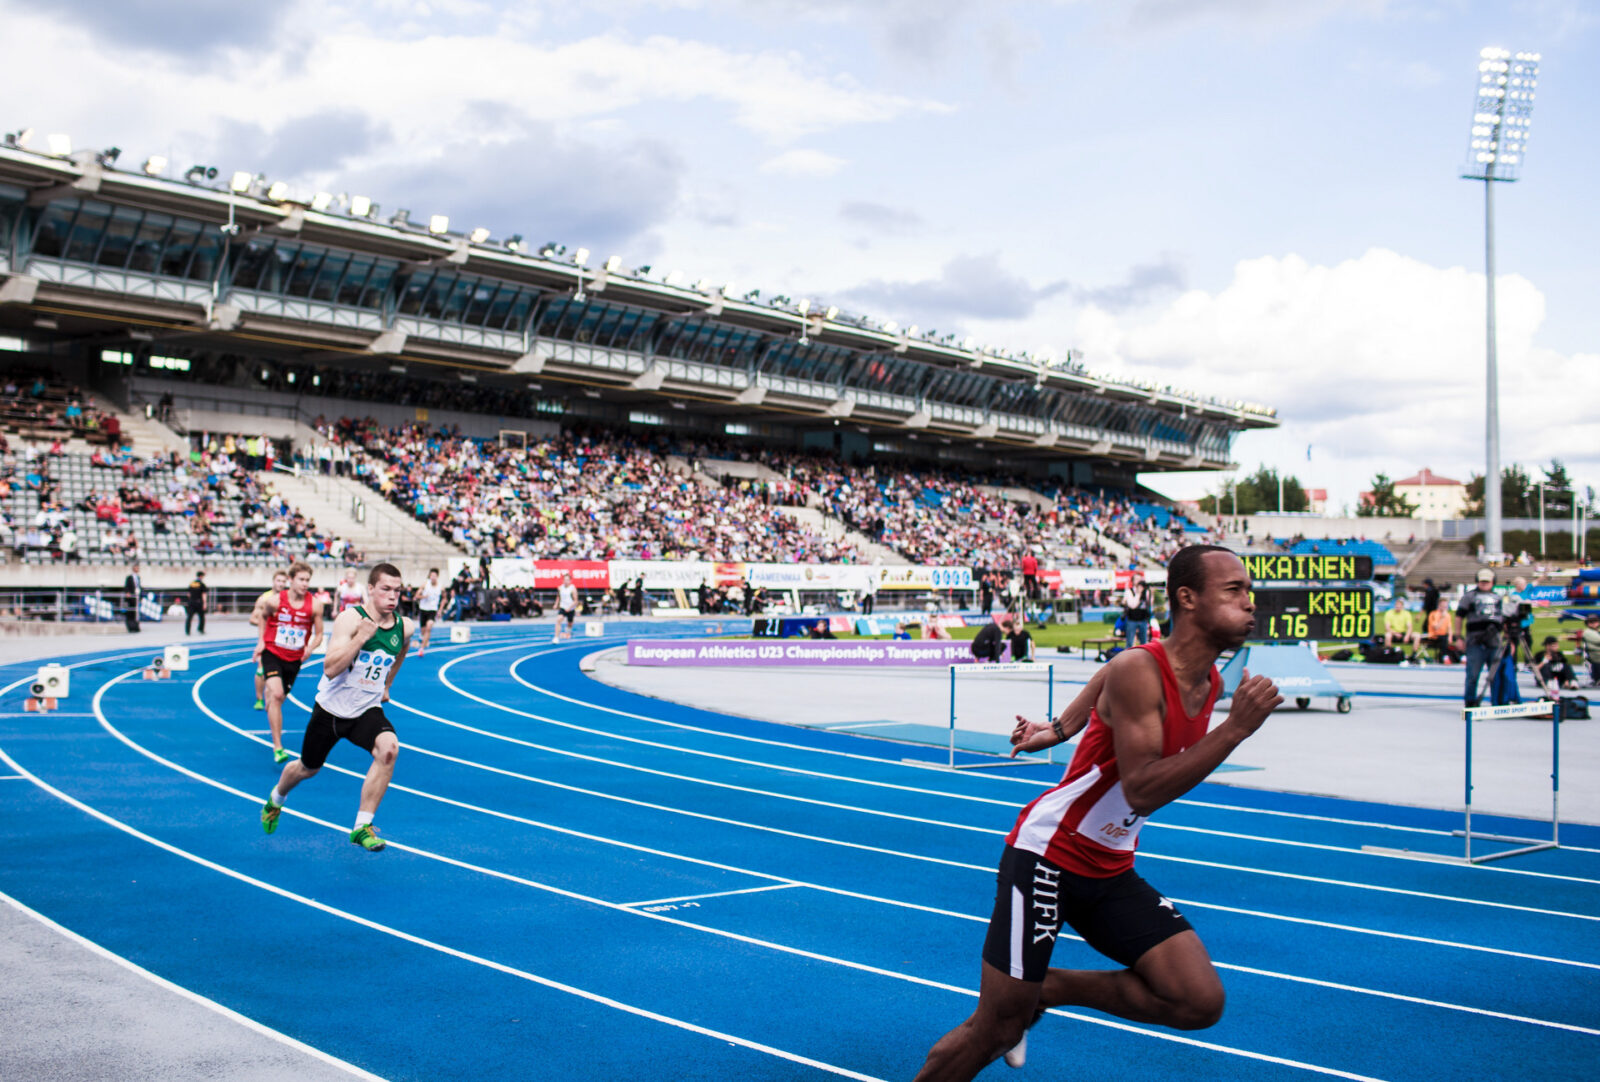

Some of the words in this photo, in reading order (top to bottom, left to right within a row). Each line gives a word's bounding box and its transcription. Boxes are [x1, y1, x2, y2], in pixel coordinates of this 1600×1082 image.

[572, 569, 608, 579] SEAT
[1236, 556, 1355, 579] NKAINEN
[1308, 592, 1371, 614] KRHU
[1269, 614, 1308, 638] 1.76
[1332, 614, 1371, 638] 1.00
[634, 645, 696, 662] European
[698, 645, 757, 659] Athletics
[758, 646, 784, 660] U23
[786, 645, 885, 662] Championships
[885, 645, 943, 662] Tampere
[365, 665, 382, 681] 15
[1032, 861, 1061, 945] HIFK
